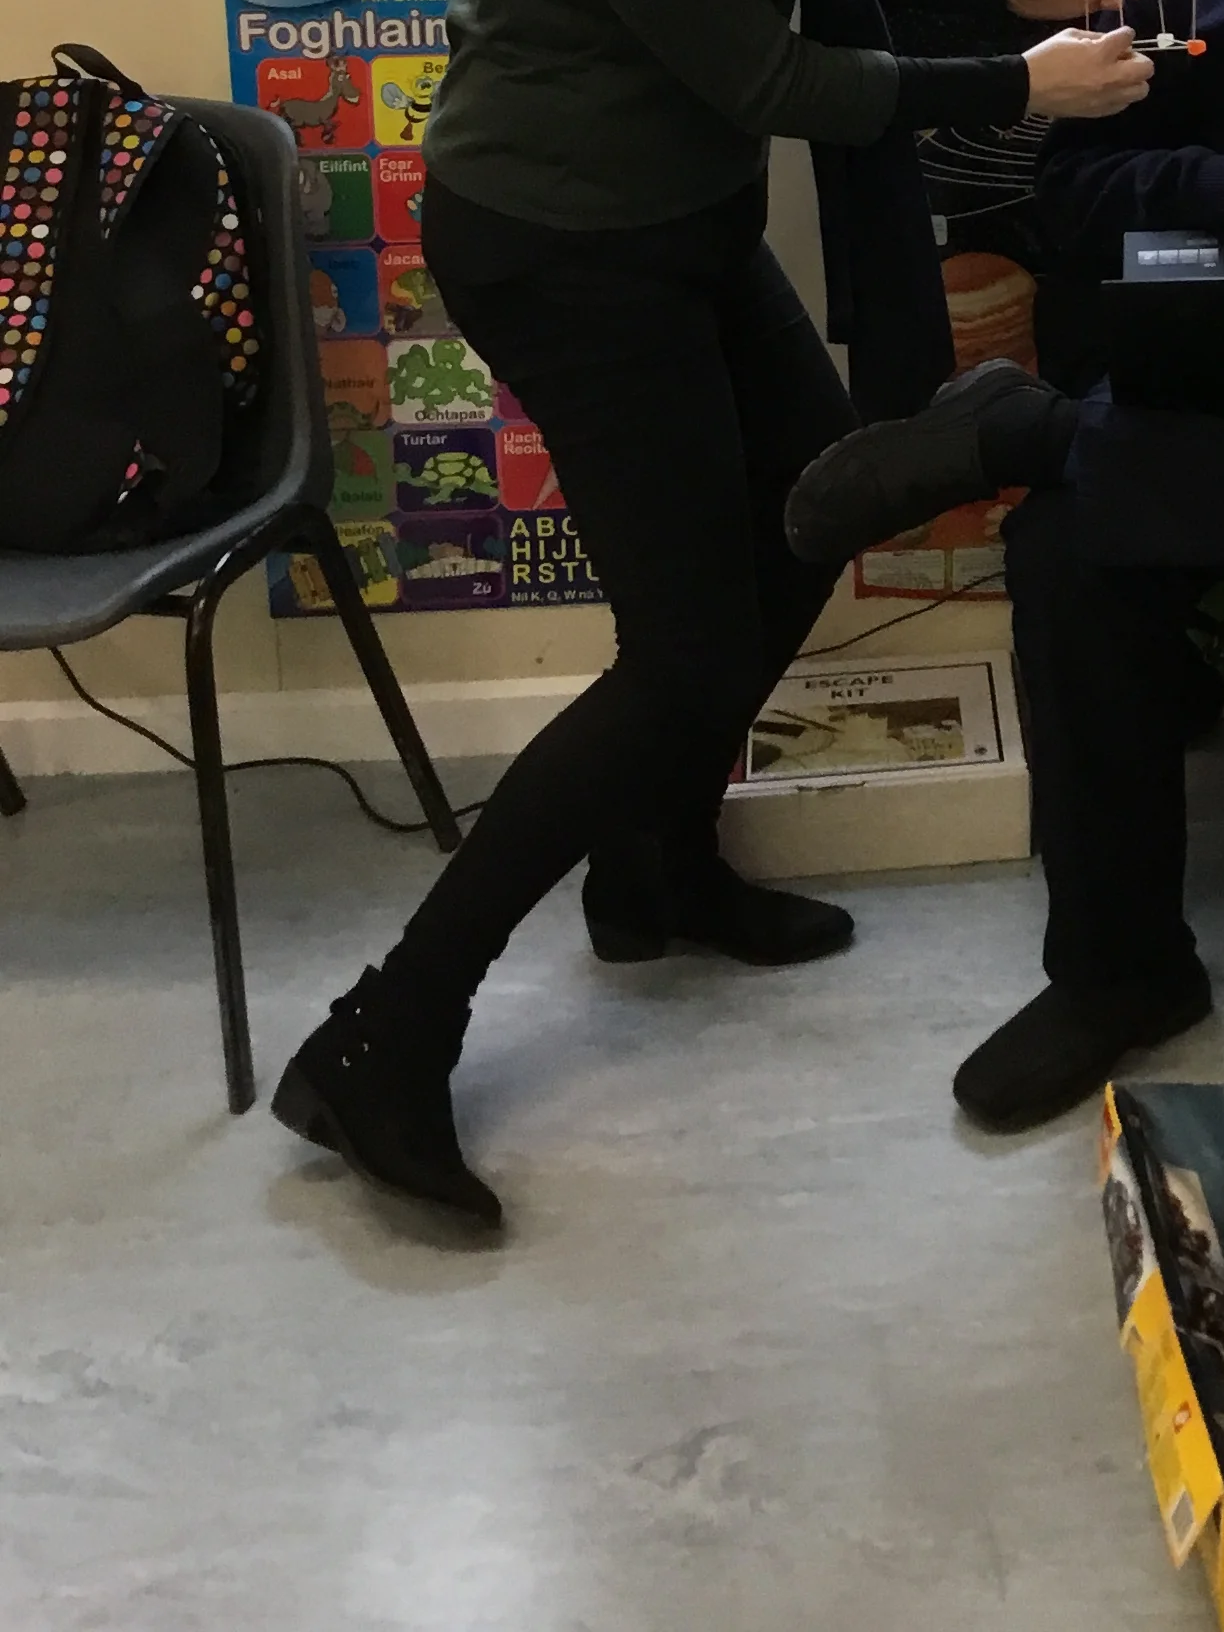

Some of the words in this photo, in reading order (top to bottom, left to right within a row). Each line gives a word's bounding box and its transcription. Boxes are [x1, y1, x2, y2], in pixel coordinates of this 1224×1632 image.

[267, 67, 302, 81] Asal
[379, 158, 413, 171] Fear
[379, 170, 423, 183] Grinn
[414, 408, 486, 423] Ochtapas
[401, 432, 448, 446] Turtar
[503, 431, 542, 443] Uach
[804, 674, 894, 690] ESCAPE
[830, 687, 868, 700] KIT
